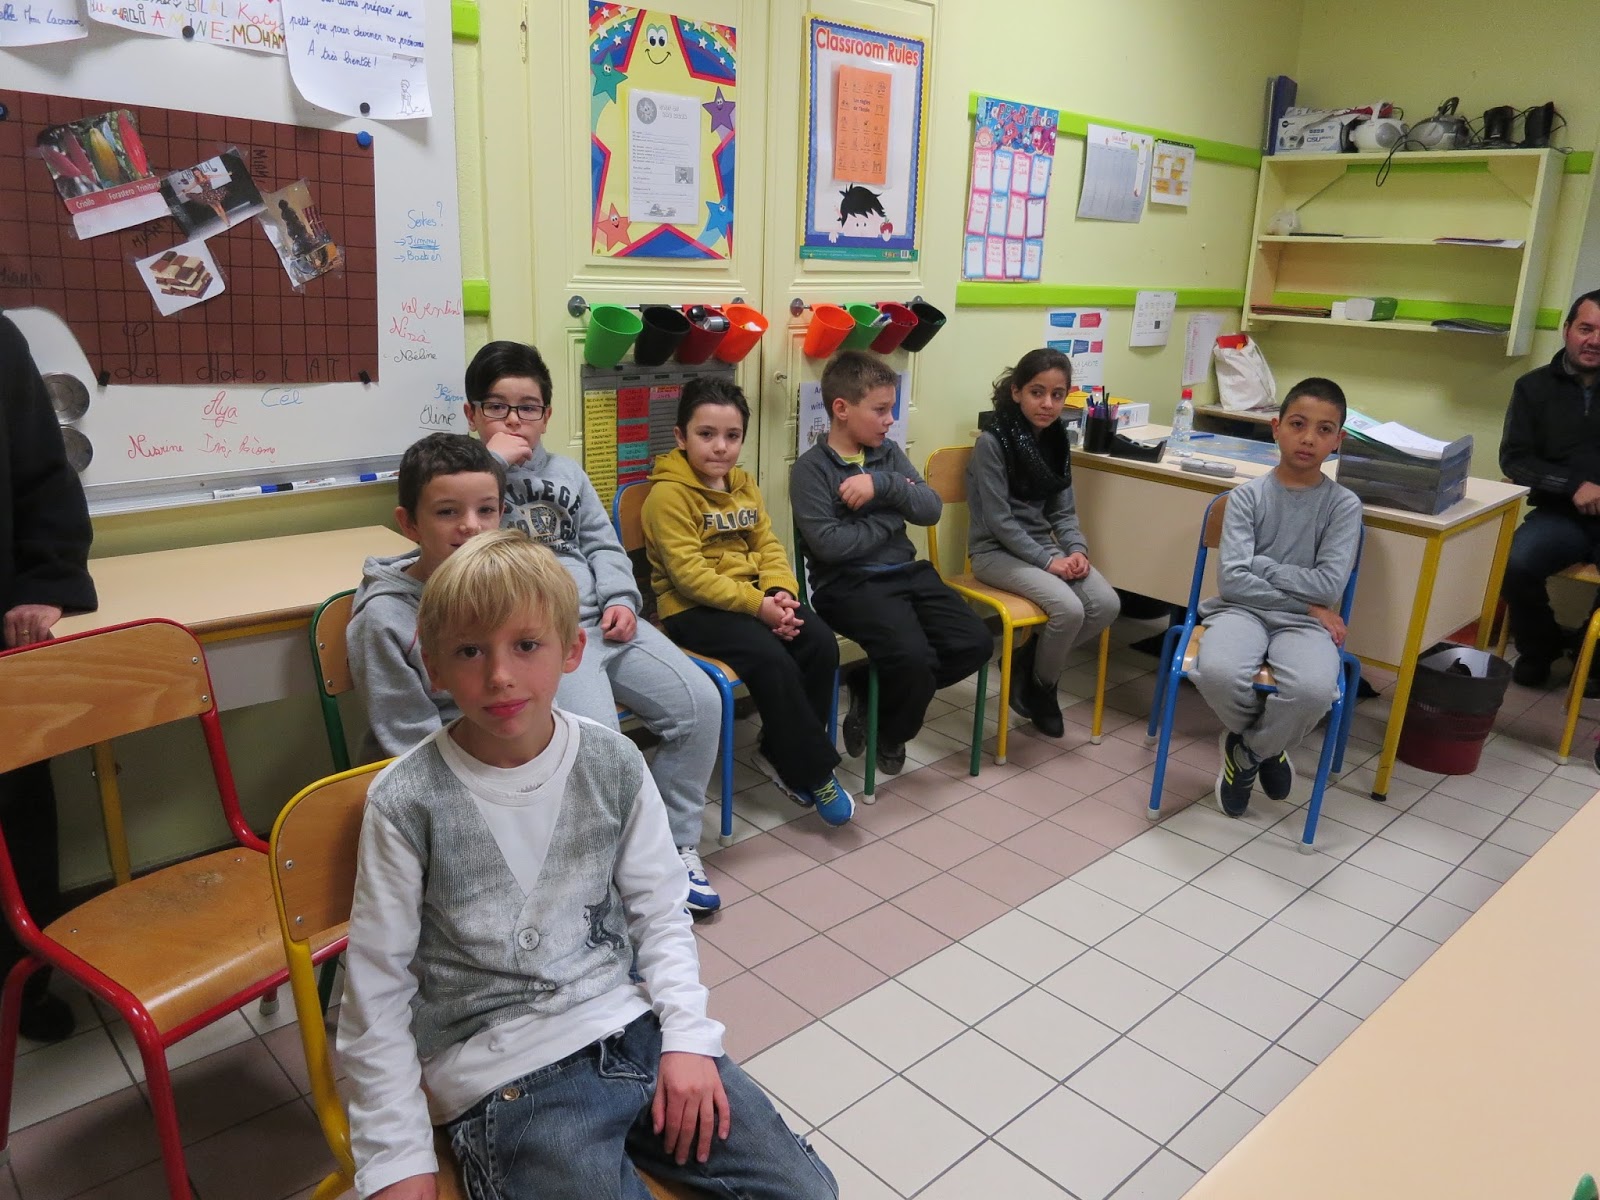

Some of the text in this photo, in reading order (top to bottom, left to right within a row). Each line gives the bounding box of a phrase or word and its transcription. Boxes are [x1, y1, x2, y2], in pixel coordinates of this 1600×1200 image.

[289, 16, 311, 30] petit
[330, 25, 350, 38] pour
[307, 39, 315, 56] A
[815, 27, 919, 67] Classroom Rules
[76, 197, 95, 210] Criollo
[108, 188, 135, 202] Forastero
